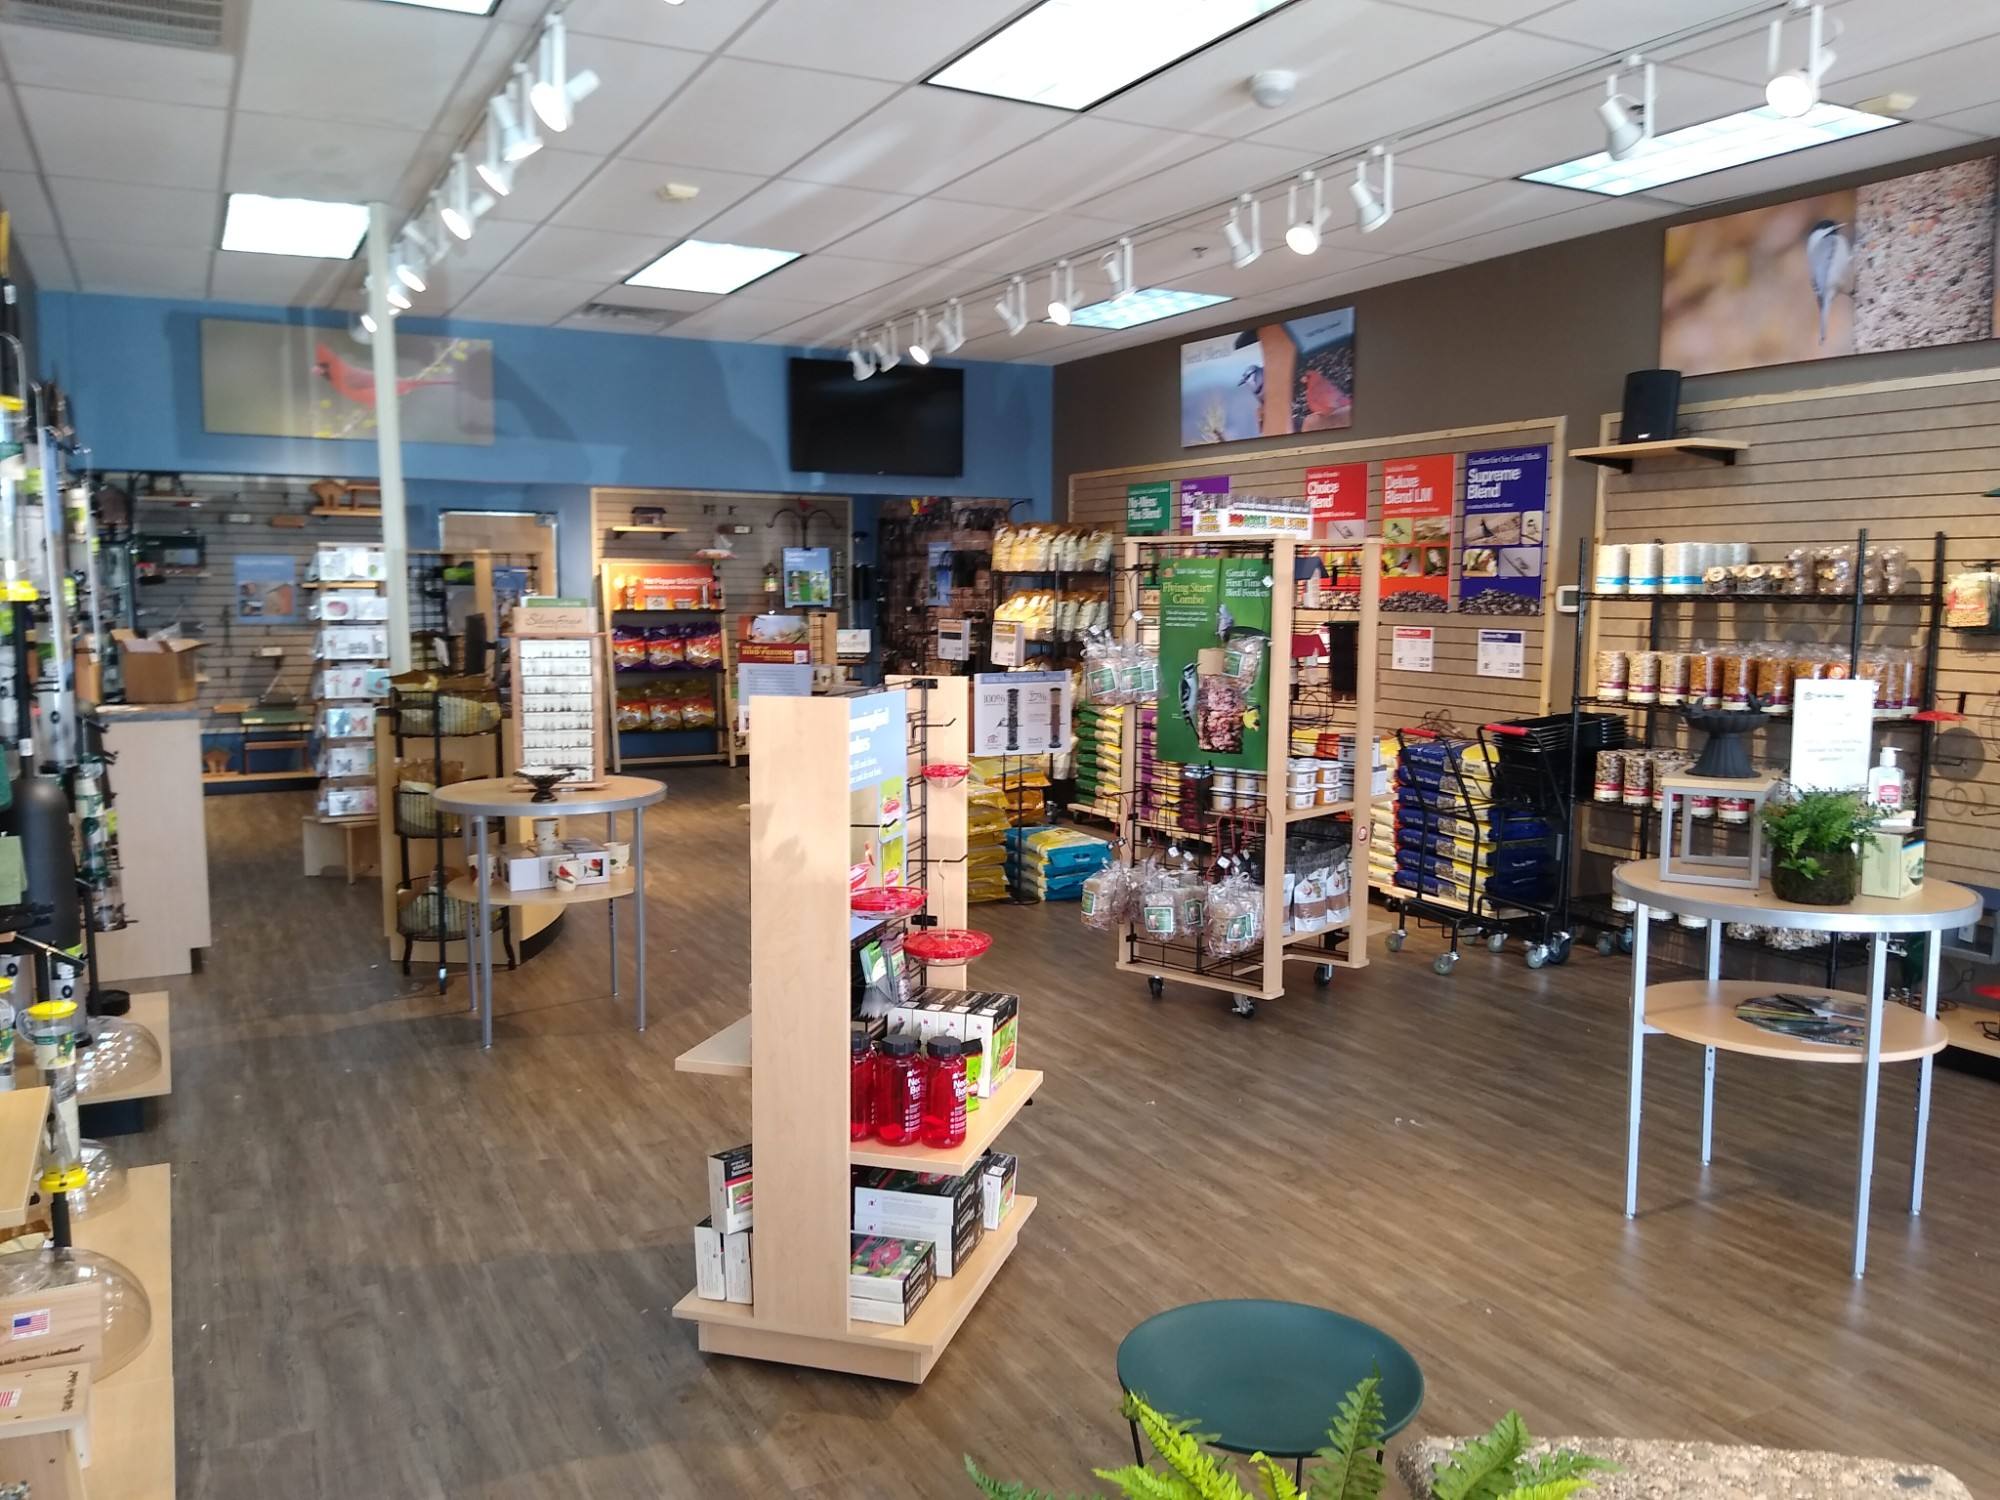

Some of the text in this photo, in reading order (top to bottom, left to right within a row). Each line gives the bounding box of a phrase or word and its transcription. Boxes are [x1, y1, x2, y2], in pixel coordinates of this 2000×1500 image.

[1384, 475, 1420, 489] Deluxe
[1468, 467, 1522, 485] Supreme
[1307, 480, 1340, 495] Choice
[1467, 482, 1501, 499] Blend
[1384, 490, 1412, 505] Blend
[1225, 568, 1245, 577] Great
[1246, 567, 1258, 577] for
[1162, 581, 1189, 596] Flying
[1225, 578, 1262, 588] First Time
[1172, 593, 1205, 605] Combo
[1225, 587, 1241, 597] Bird
